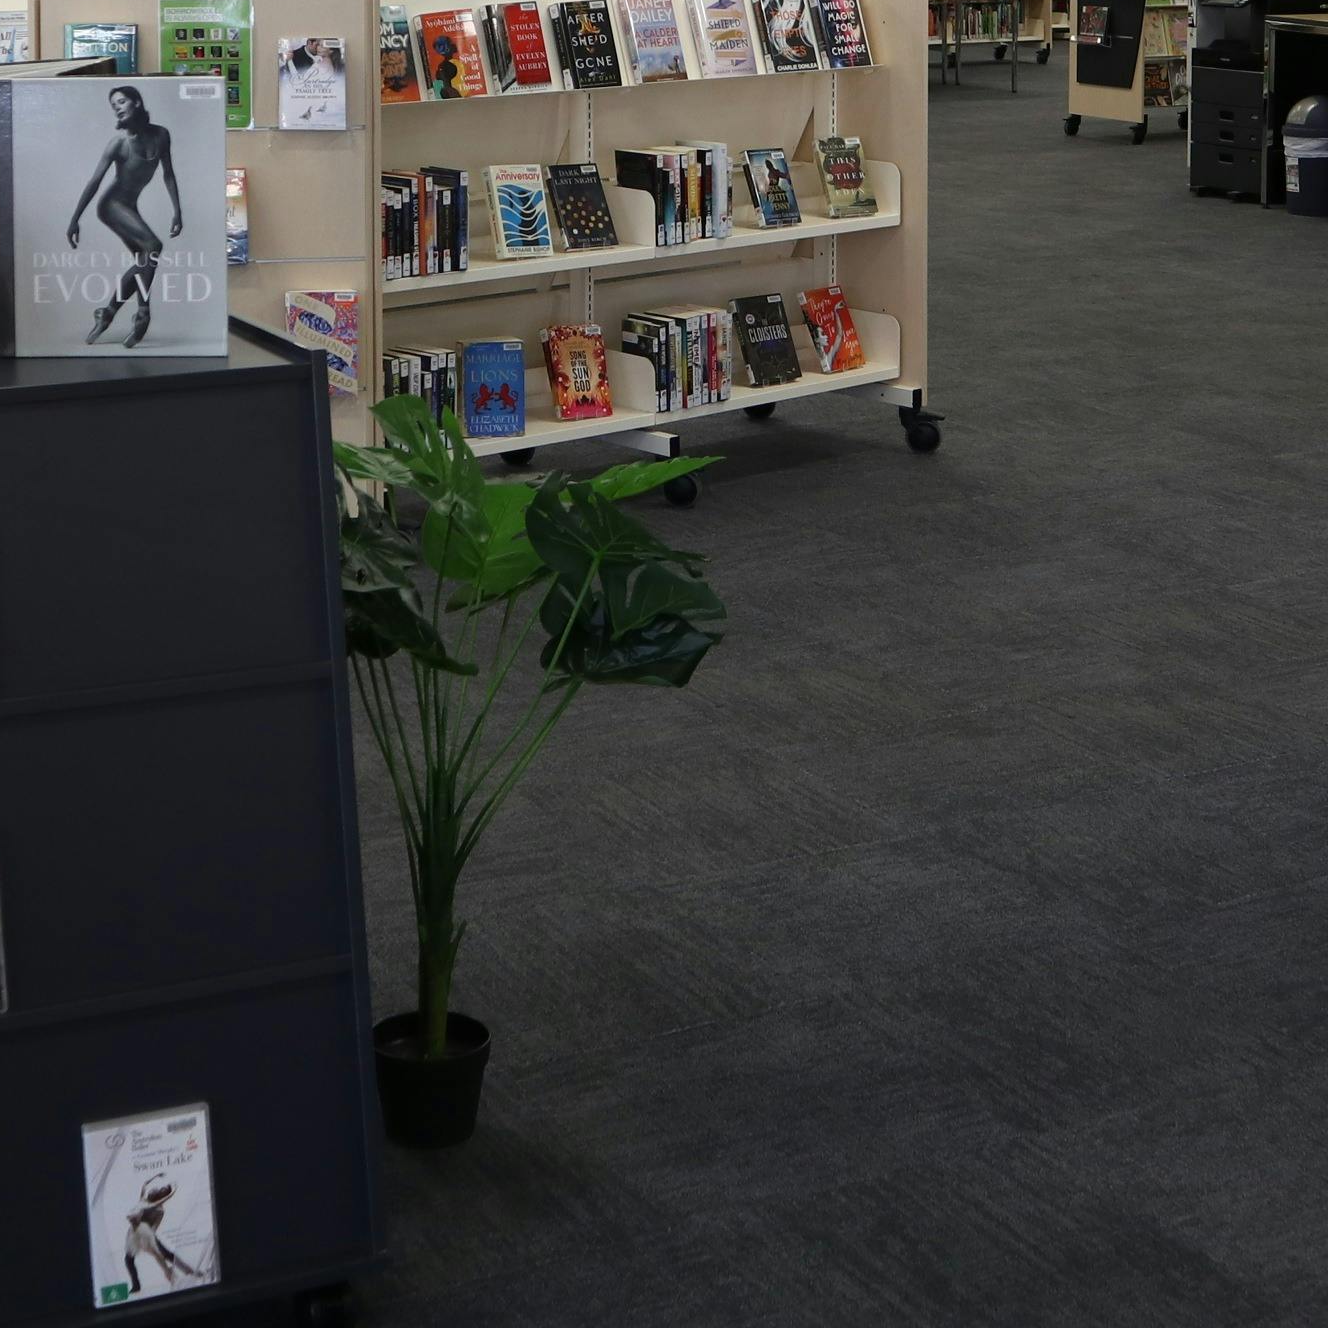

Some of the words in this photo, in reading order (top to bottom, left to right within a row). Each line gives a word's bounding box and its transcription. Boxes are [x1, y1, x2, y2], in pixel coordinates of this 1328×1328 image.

[823, 1, 841, 11] WILL
[842, 0, 855, 9] DO
[567, 13, 604, 24] AFTER
[631, 9, 672, 23] DAILEY
[827, 12, 855, 21] MAGIC
[510, 22, 540, 32] STOLEN
[708, 19, 741, 30] SHIELD
[836, 23, 853, 31] FOR
[517, 33, 538, 41] BOOK
[643, 28, 677, 38] CALDER
[834, 33, 860, 43] SMALL
[572, 36, 608, 47] SHE'D
[637, 38, 649, 48] AT
[651, 37, 679, 47] HEART
[709, 39, 748, 51] MAIDEN
[831, 44, 866, 54] CHANGE
[459, 54, 478, 63] Spell
[516, 52, 545, 60] EVELYN
[518, 62, 547, 71] AUBREY
[576, 56, 613, 69] GONE
[459, 83, 483, 91] Things
[496, 172, 540, 182] Anniversary
[554, 177, 571, 185] LAST
[573, 176, 597, 185] NIGHT
[827, 173, 865, 181] OTHER
[33, 252, 113, 268] DARCEY
[120, 251, 209, 268] BUSSELL
[33, 273, 213, 303] EVOLVED
[748, 324, 787, 342] CLOISTERS
[467, 355, 521, 364] MARRIAGE
[570, 350, 586, 360] SONG
[472, 369, 518, 383] LIONS
[573, 368, 590, 378] SUN
[574, 380, 591, 392] GOD
[471, 415, 519, 424] ELIZABETH
[469, 423, 520, 432] CHADWICK
[133, 1159, 163, 1172] Swan
[167, 1153, 193, 1167] Lake
